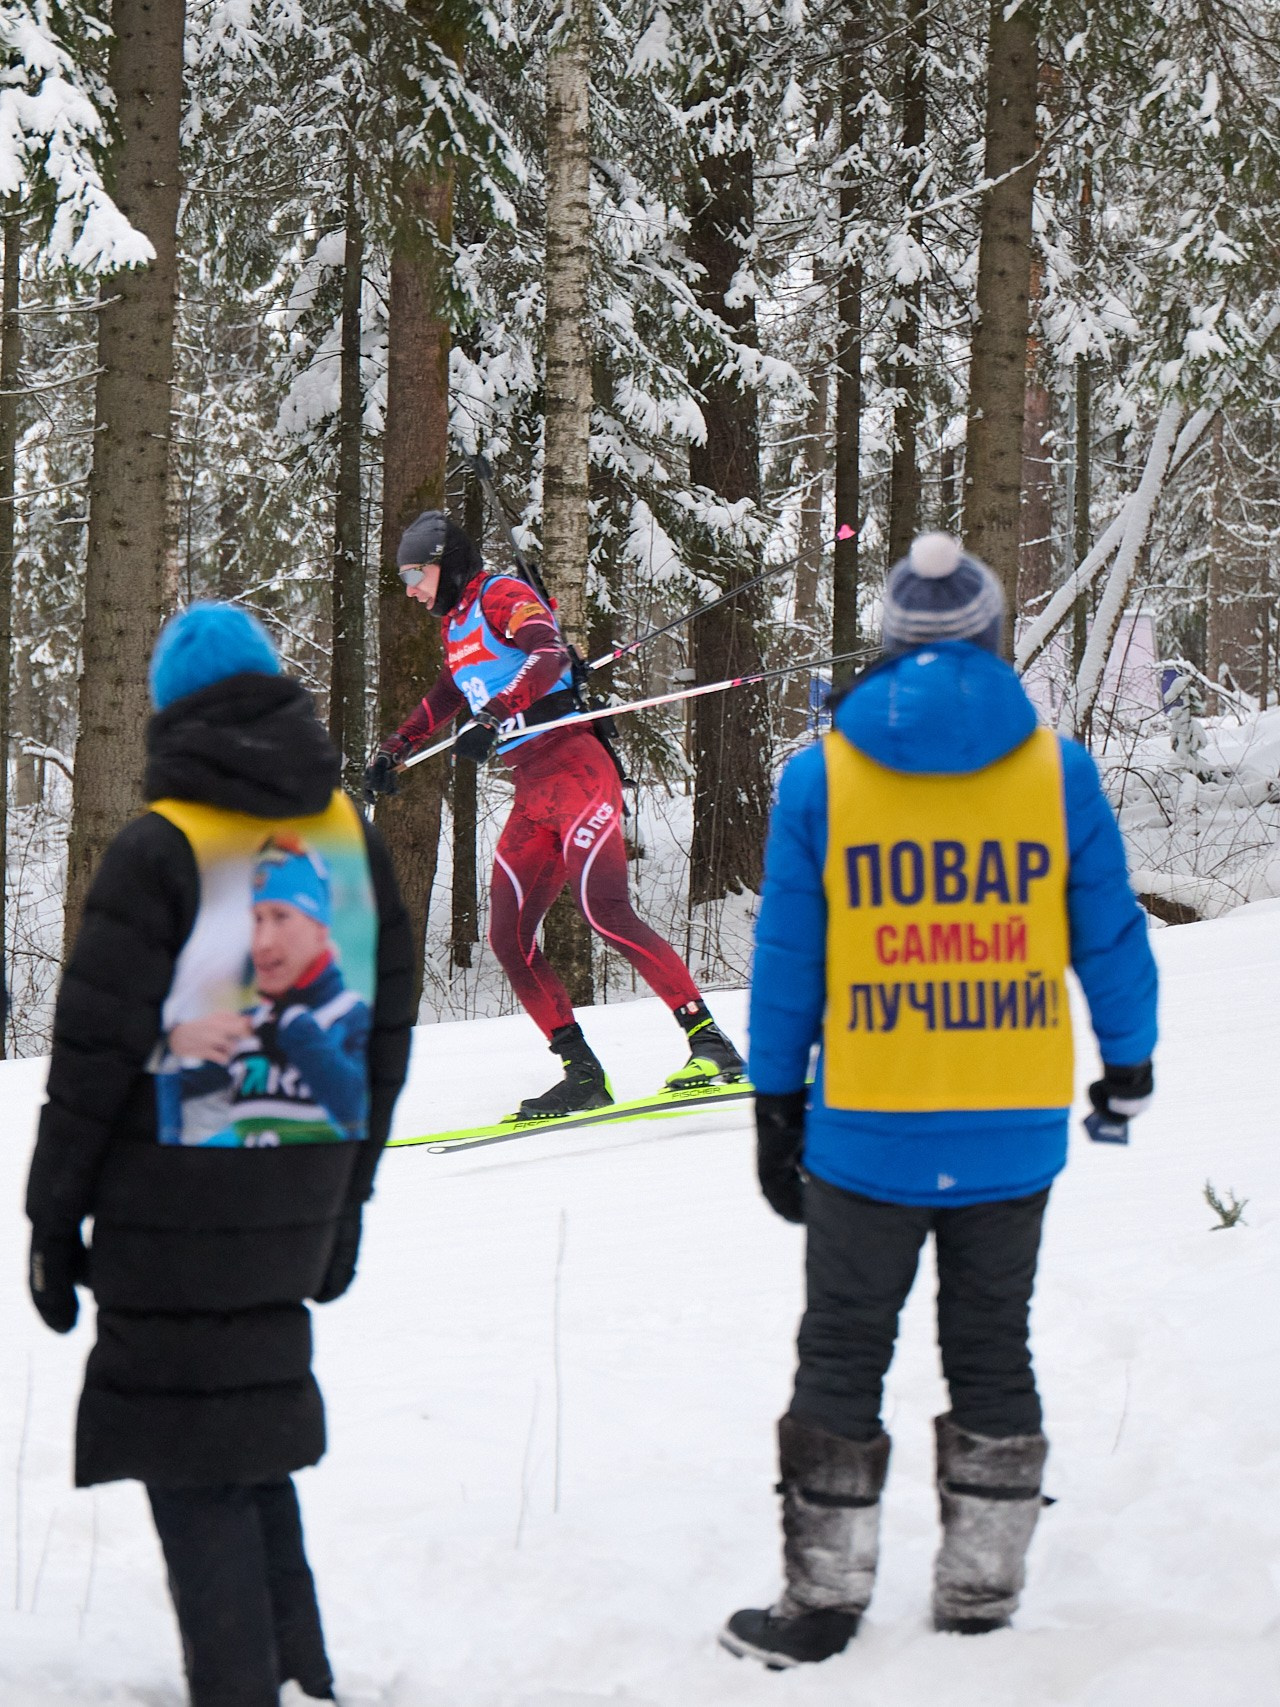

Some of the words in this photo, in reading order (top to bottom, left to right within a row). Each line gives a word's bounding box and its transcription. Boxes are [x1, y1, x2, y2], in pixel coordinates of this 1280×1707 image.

[587, 802, 614, 830] ПСБ
[845, 840, 1051, 908] ПОВАР
[875, 914, 1027, 966] САМЫЙ
[848, 969, 1058, 1032] ЛУЧШИЙ!
[672, 1087, 721, 1100] FISCHER
